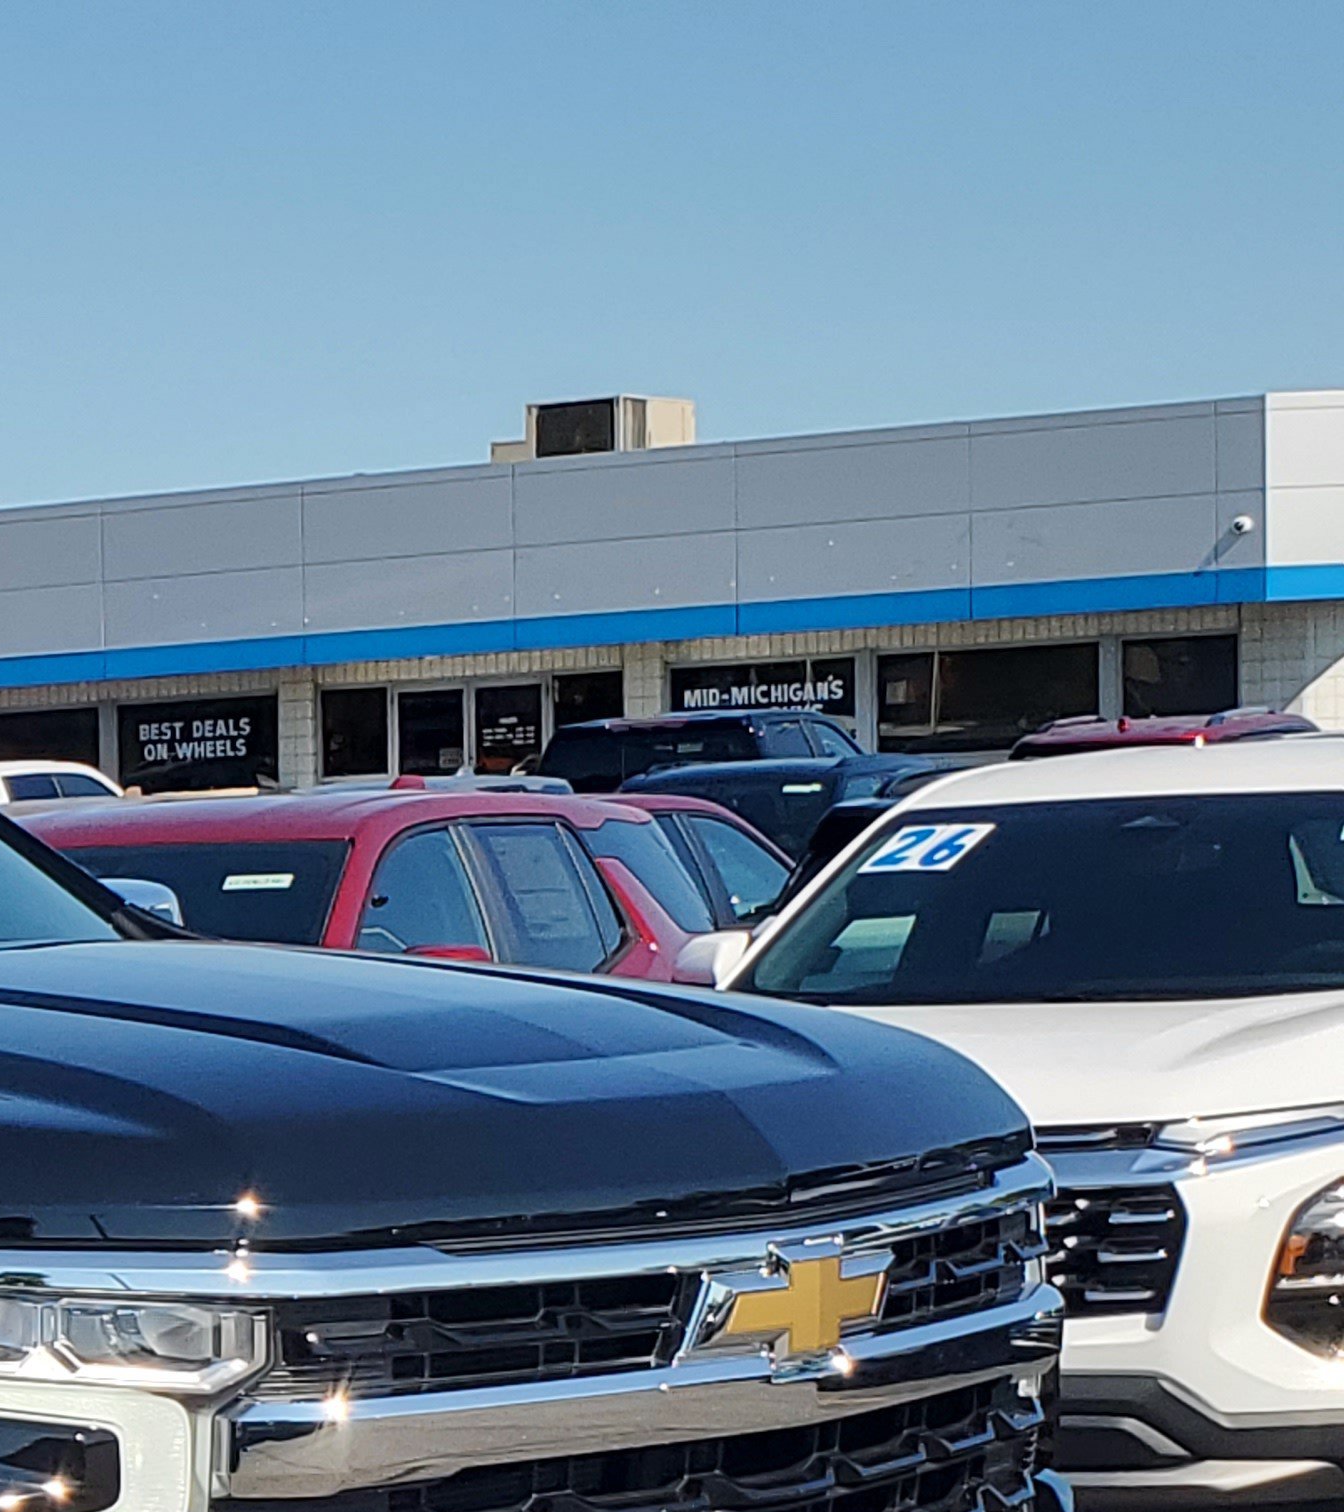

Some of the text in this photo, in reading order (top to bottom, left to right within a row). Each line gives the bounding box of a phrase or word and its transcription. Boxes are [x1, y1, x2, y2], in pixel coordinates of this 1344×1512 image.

[683, 675, 844, 708] MID-MICHIGAN'S
[139, 717, 251, 741] BEST DEALS
[144, 738, 247, 761] ON WHEELS
[869, 828, 976, 867] 26
